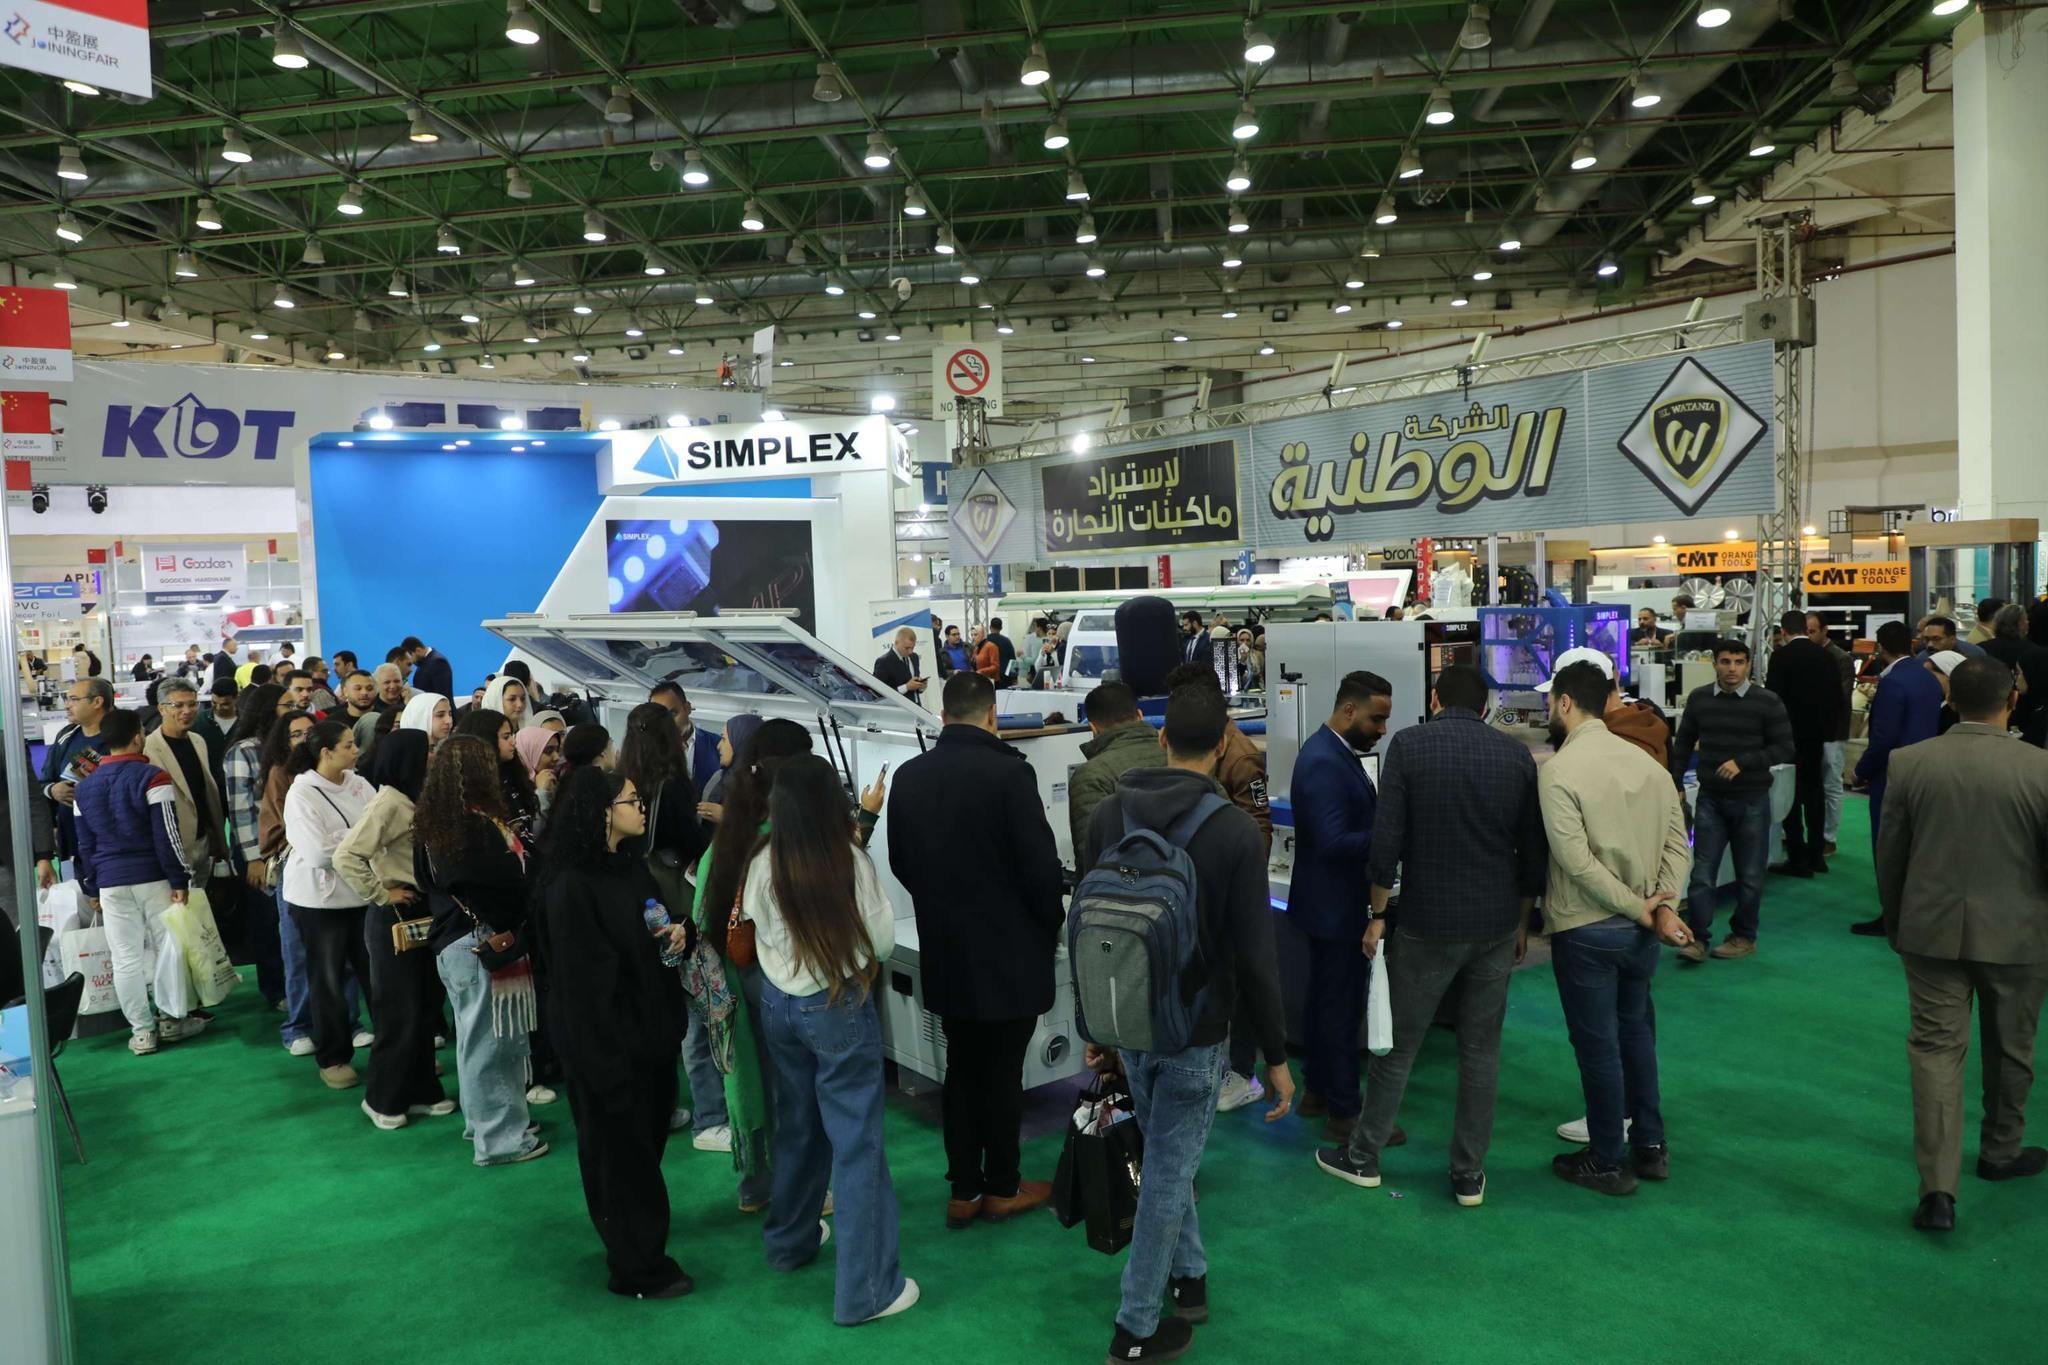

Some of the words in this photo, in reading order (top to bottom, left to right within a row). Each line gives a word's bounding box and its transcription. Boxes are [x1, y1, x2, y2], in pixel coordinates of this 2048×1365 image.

[48, 26, 99, 50] 中盈展
[941, 402, 953, 411] NO
[1671, 402, 1715, 413] WATANIA
[1404, 402, 1510, 441] الشركة
[687, 432, 862, 469] SIMPLEX
[1269, 407, 1567, 542] الوطنية
[1052, 503, 1125, 543] النجارة
[1129, 496, 1232, 535] ماكينات
[1383, 548, 1417, 560] bron
[1677, 551, 1718, 567] CMT
[1807, 567, 1858, 586] CMT
[1861, 567, 1907, 576] ORANGE
[1862, 575, 1897, 584] TOOLS
